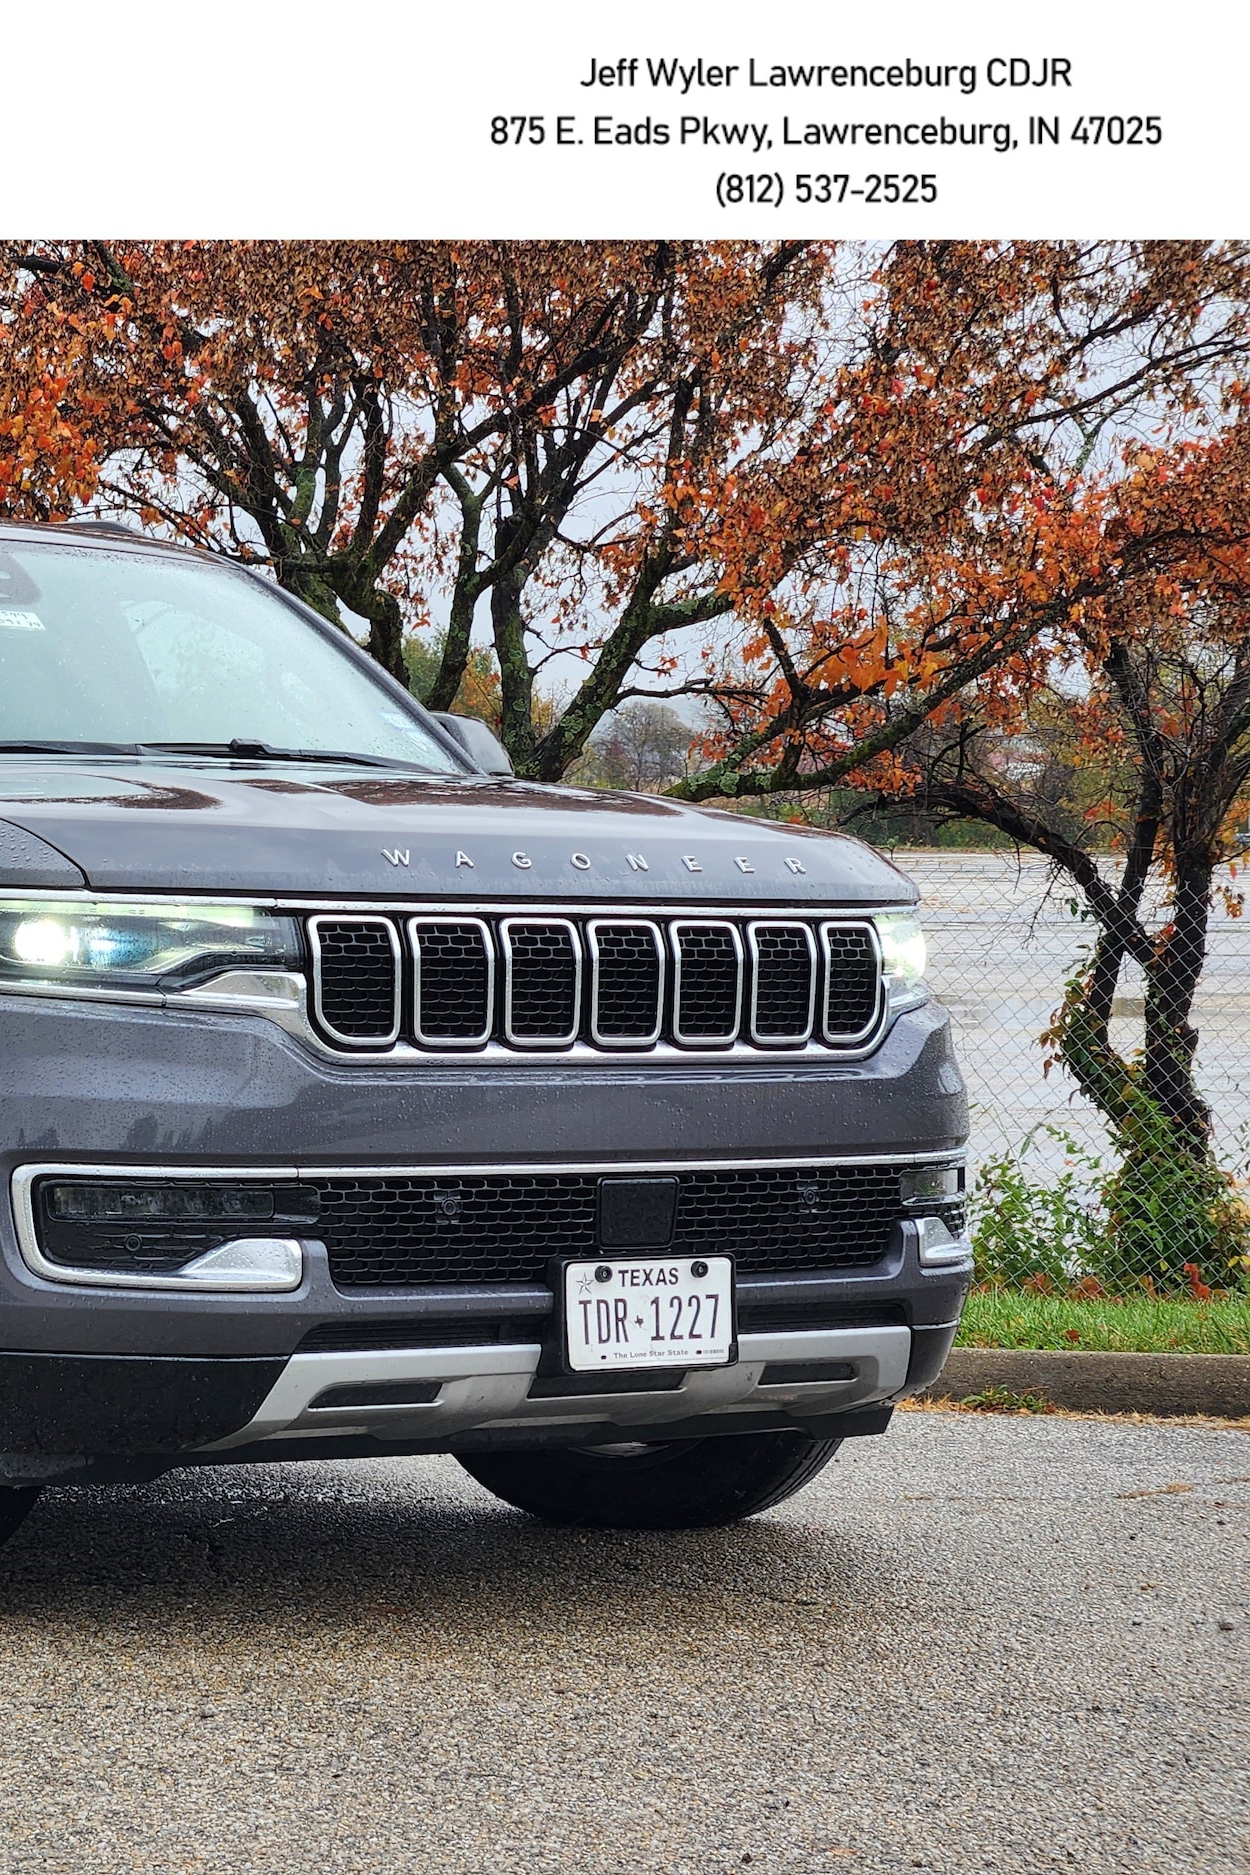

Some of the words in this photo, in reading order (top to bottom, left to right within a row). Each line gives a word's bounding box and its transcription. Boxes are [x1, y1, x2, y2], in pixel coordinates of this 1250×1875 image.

[380, 847, 807, 875] WAGONEER
[617, 1267, 680, 1288] TEXAS
[578, 1297, 630, 1345] TDR
[649, 1293, 720, 1341] 1227
[613, 1352, 628, 1360] The
[629, 1351, 649, 1359] Lone
[649, 1349, 666, 1358] Star
[667, 1348, 690, 1357] State
